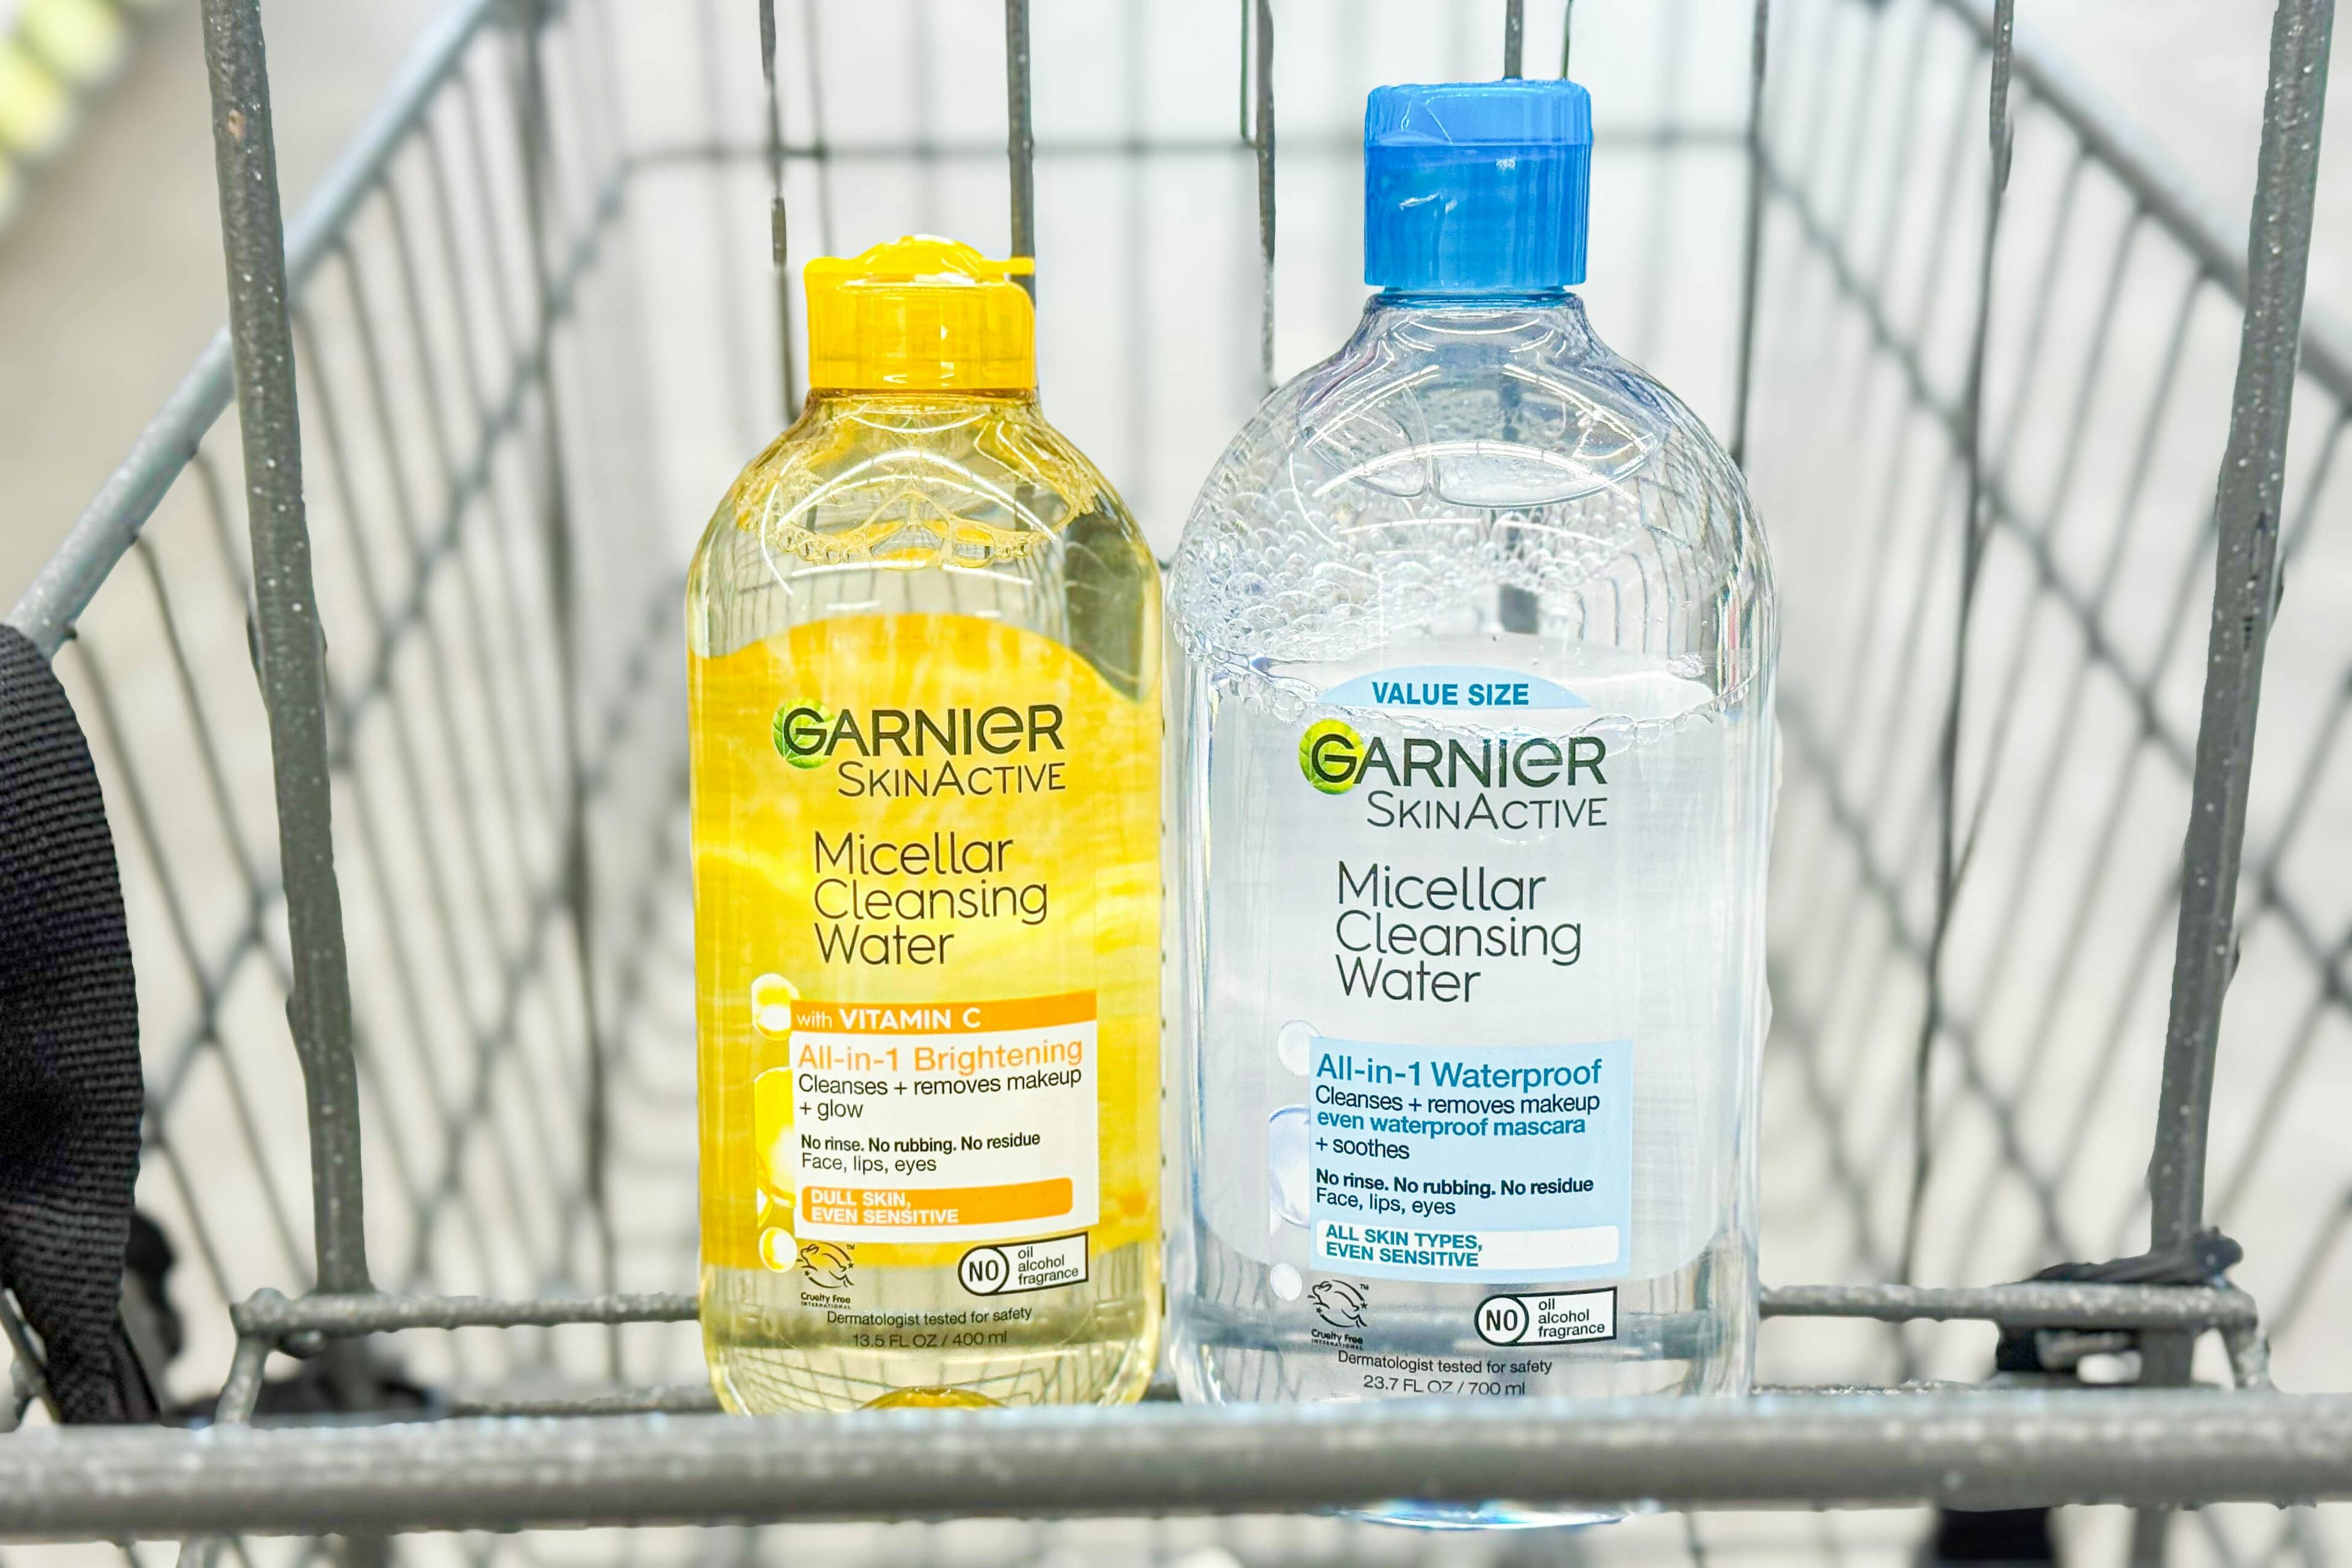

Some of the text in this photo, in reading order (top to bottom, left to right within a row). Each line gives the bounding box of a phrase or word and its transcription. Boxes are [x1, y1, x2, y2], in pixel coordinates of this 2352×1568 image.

[1372, 681, 1529, 706] VALUE SIZE
[814, 831, 1013, 875] Micellar
[1339, 861, 1546, 911] Micellar
[814, 878, 1047, 926] Cleansing
[814, 922, 954, 965] Water
[1336, 910, 1581, 966] Cleansing
[1336, 954, 1481, 1002] Water
[797, 1008, 980, 1029] with VITAMIN C
[798, 1039, 1083, 1076] All-in-1 Brightening
[799, 1067, 1082, 1095] Cleanses + removes makeup
[1316, 1053, 1602, 1093] All-in-1 Waterproof
[799, 1100, 864, 1120] + glow
[1316, 1085, 1600, 1114] Cleanses + removes makeup
[1317, 1111, 1585, 1139] even waterproof mascara
[802, 1133, 1040, 1154] No rinse. No rubbing. No residue
[1316, 1138, 1410, 1159] + soothes
[802, 1153, 937, 1174] Face, lips, eyes
[1316, 1169, 1594, 1198] No rinse. No rubbing. No residue
[811, 1189, 911, 1209] DULL SKIN,
[1316, 1188, 1455, 1215] Face, lips, eyes
[811, 1208, 959, 1224] EVEN SENSITIVE
[1326, 1225, 1483, 1252] ALL SKIN TYPES,
[1018, 1246, 1033, 1259] oil
[1018, 1254, 1064, 1272] alcohol
[1326, 1242, 1479, 1266] EVEN SENSITIVE
[969, 1260, 999, 1282] NO
[1018, 1268, 1078, 1285] fragrance
[801, 1292, 850, 1303] Cruelty Free
[1539, 1299, 1555, 1310] oil
[827, 1307, 1032, 1328] Dermatologist tested for safety
[1486, 1310, 1518, 1331] NO
[1538, 1308, 1589, 1324] alcohol
[853, 1334, 884, 1347] 13.5
[889, 1336, 907, 1347] FL
[913, 1334, 937, 1348] OZ
[952, 1333, 984, 1345] 400
[989, 1331, 1007, 1343] ml
[1311, 1328, 1363, 1344] Cruelty Free
[1538, 1323, 1604, 1339] fragrance
[1338, 1350, 1552, 1374] Dermatologist tested for safety
[1363, 1375, 1398, 1391] 23.7
[1404, 1379, 1423, 1393] FL
[1428, 1380, 1453, 1394] OZ
[1469, 1382, 1500, 1395] 700
[1506, 1381, 1525, 1395] ml
